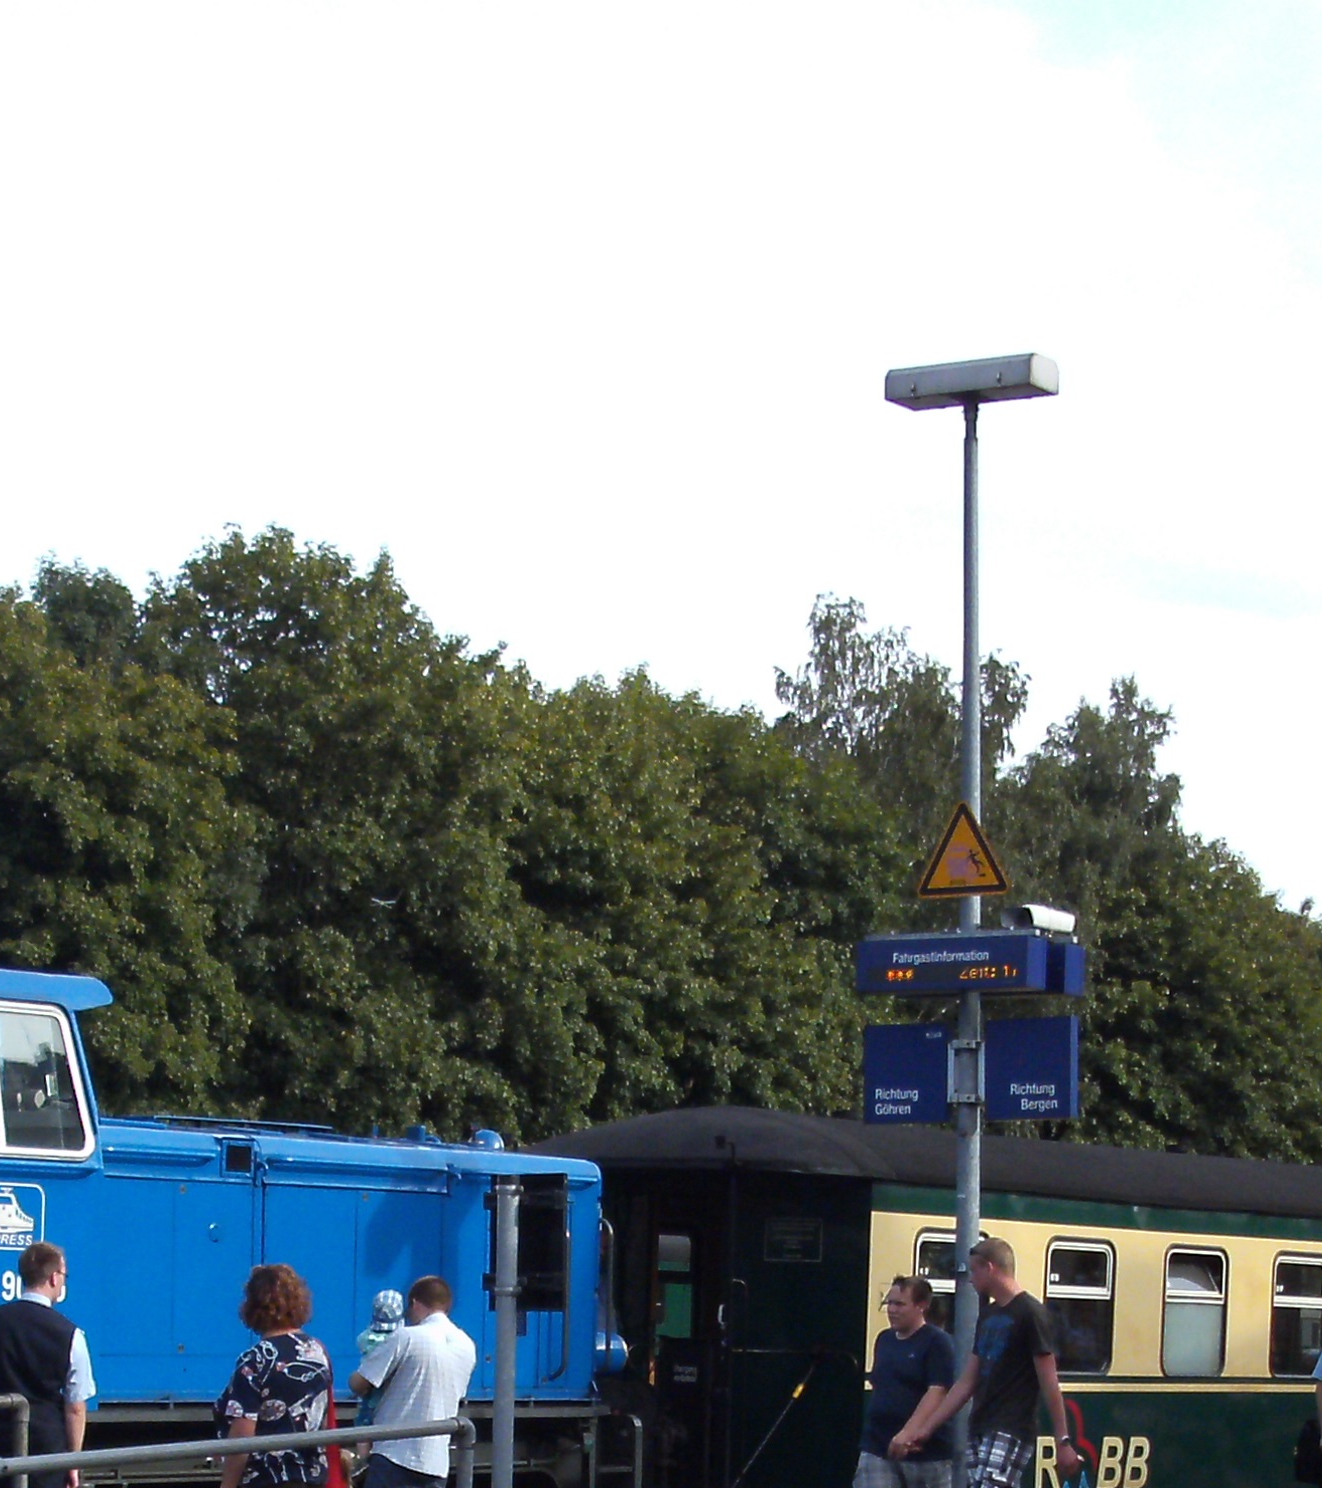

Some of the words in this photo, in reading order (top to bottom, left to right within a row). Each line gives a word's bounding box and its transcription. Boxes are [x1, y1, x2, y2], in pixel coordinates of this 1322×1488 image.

[892, 950, 990, 965] Fahrgastinformation
[875, 1088, 919, 1102] Richtung
[1010, 1083, 1056, 1097] Richtung
[875, 1103, 912, 1115] Göhren
[1020, 1098, 1058, 1113] Bergen
